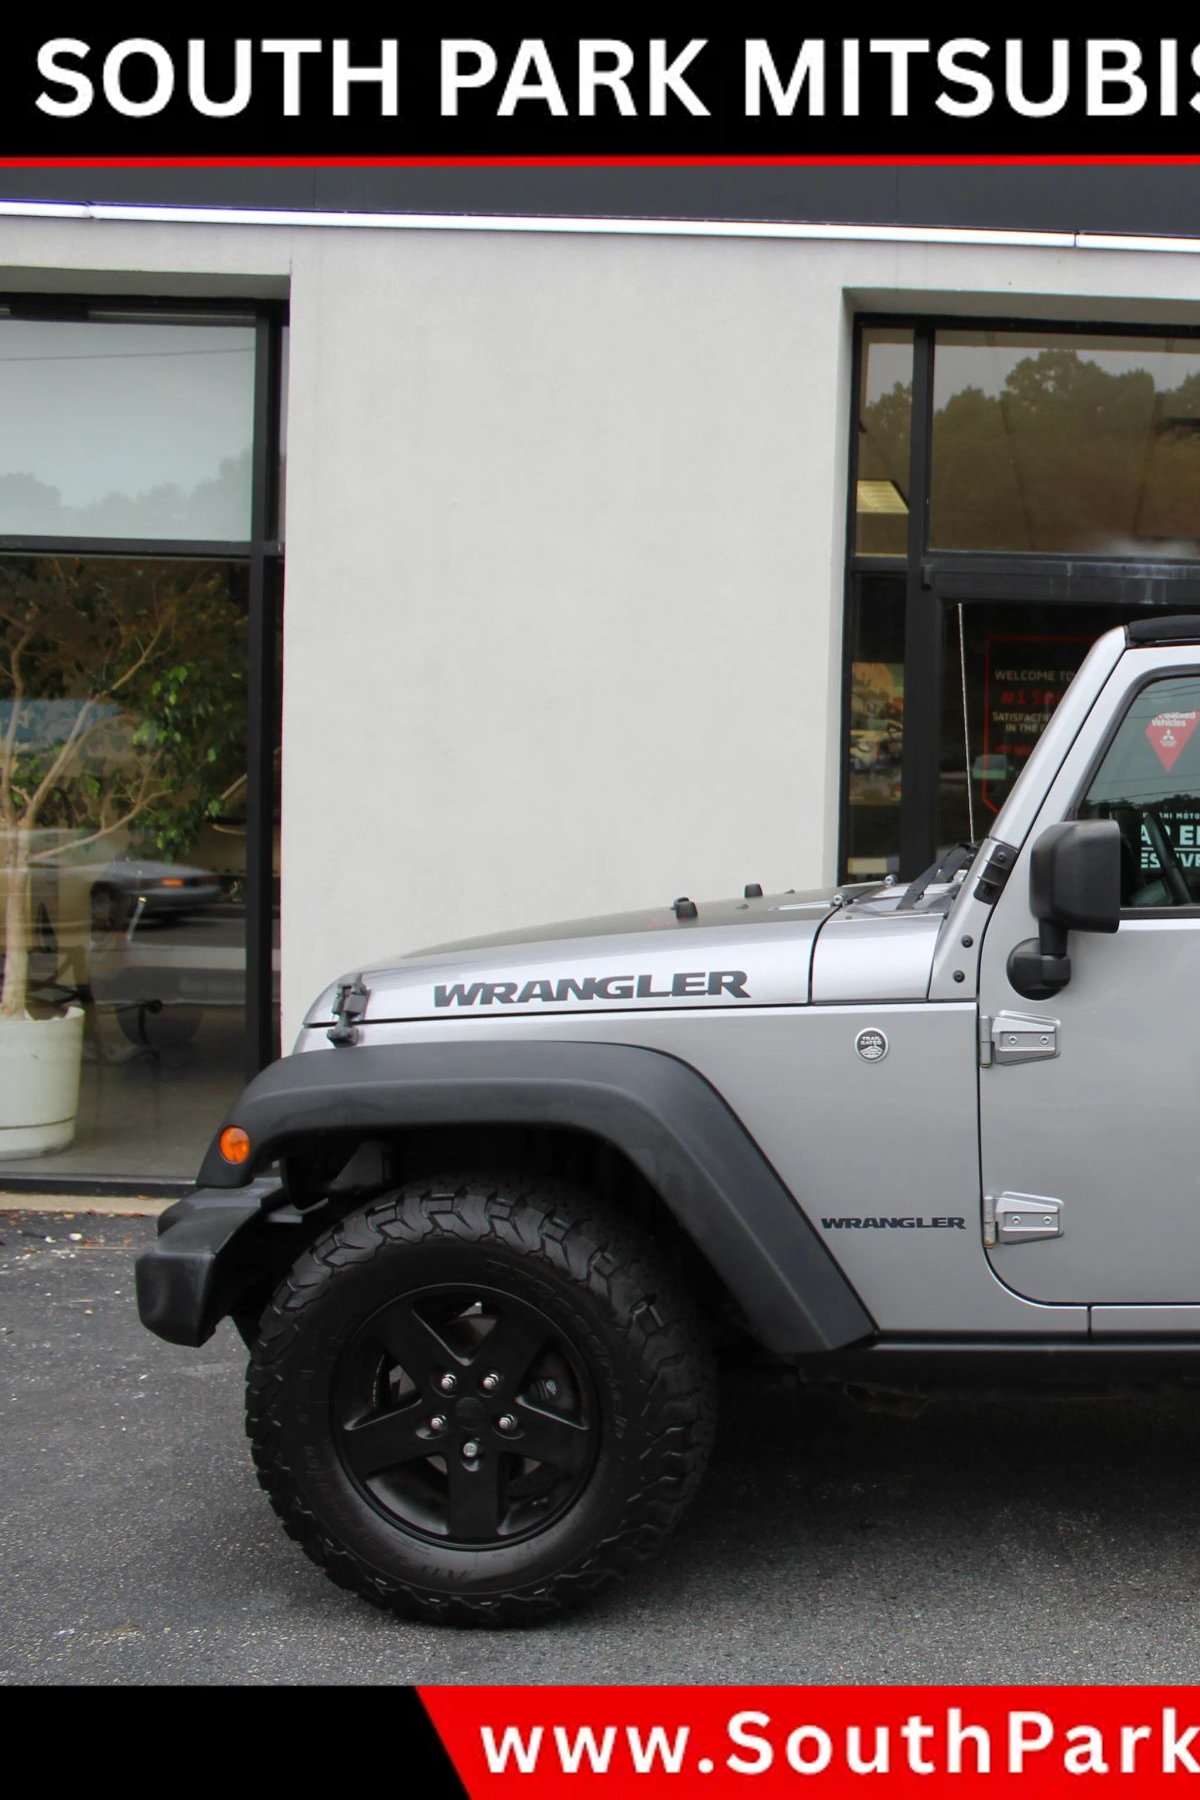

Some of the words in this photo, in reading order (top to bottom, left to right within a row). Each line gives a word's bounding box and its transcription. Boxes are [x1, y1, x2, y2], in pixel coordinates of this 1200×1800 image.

[994, 670, 1056, 681] WELCOME
[1005, 723, 1016, 732] IN
[1019, 723, 1037, 733] THE
[433, 970, 751, 1008] WRANGLER
[821, 1216, 967, 1230] WRANGLER
